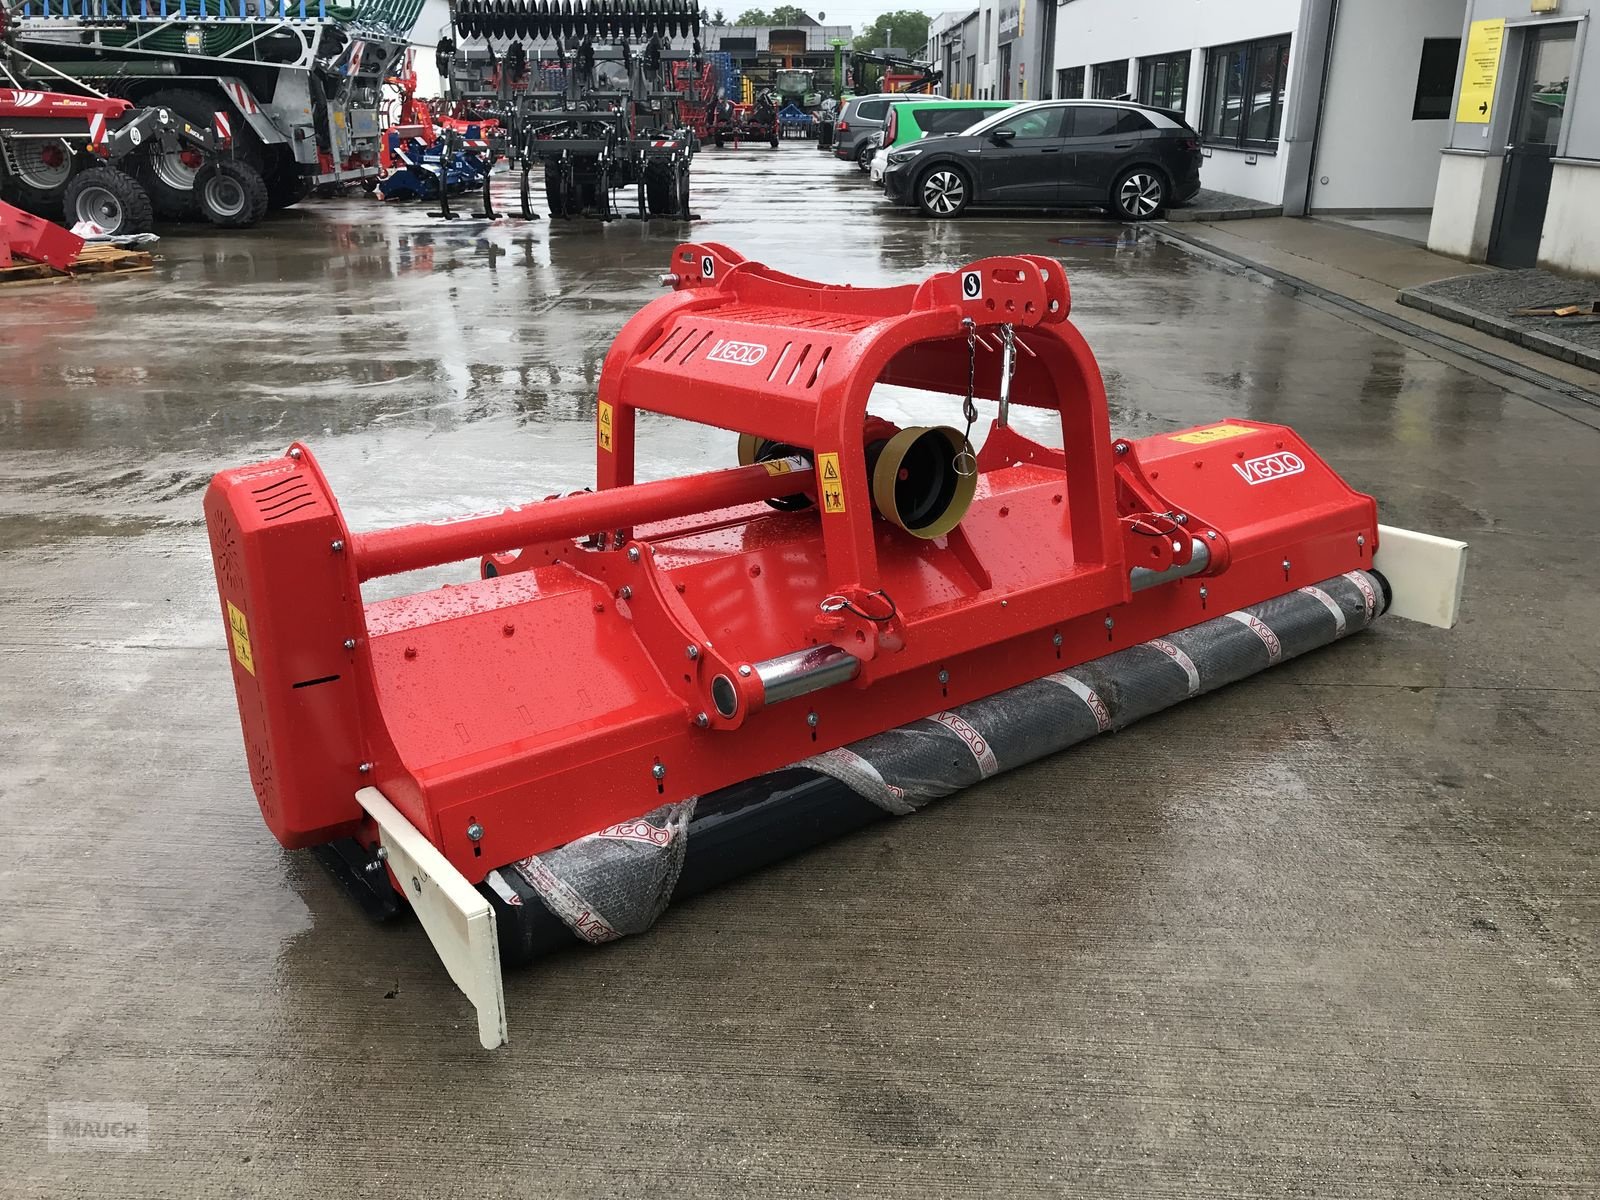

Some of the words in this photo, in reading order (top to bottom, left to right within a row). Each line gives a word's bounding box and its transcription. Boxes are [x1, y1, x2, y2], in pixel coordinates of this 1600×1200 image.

[706, 339, 767, 366] VIGOLO
[1231, 451, 1305, 485] VIGOLO
[938, 711, 986, 756] VIGOLO
